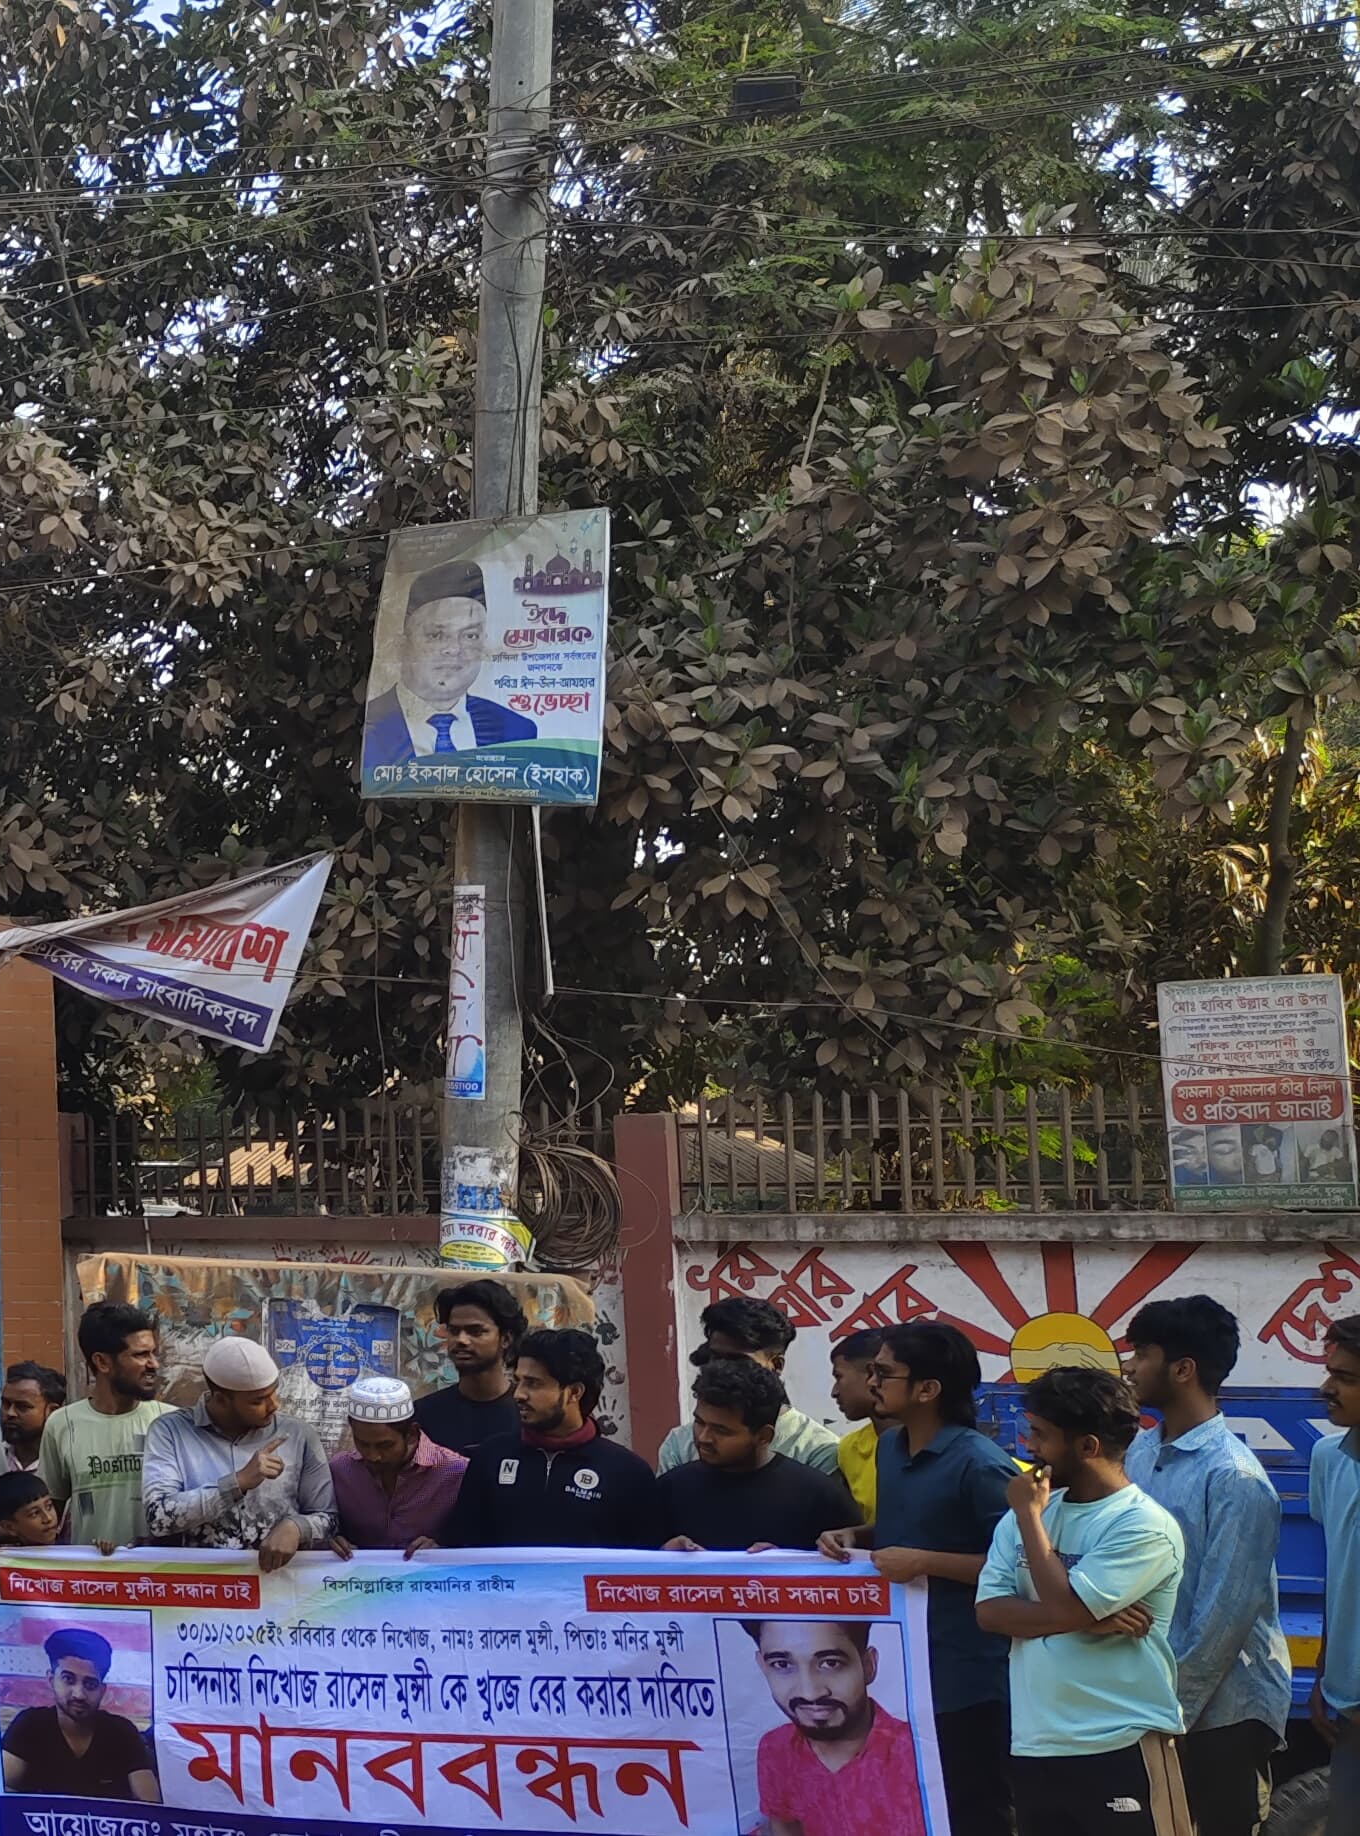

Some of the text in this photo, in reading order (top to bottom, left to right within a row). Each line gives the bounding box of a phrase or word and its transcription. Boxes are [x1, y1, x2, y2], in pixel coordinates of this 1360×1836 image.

[522, 600, 569, 625] ঈদ
[503, 626, 593, 649] মোবারক
[507, 692, 590, 715] শুভেচ্ছা
[373, 765, 402, 783] মোঃ
[408, 763, 459, 783] ইকবাল
[466, 766, 515, 784] হোসেন
[89, 962, 132, 990] সকল
[323, 1576, 403, 1594] বিসমিল্লাহির
[409, 1577, 471, 1593] রাহমানির
[597, 1580, 661, 1604] নিখোজ
[668, 1583, 724, 1604] রাসেল
[786, 1585, 840, 1606] সন্ধান
[847, 1583, 881, 1606] চাই
[167, 1711, 704, 1828] মানববন্ধন
